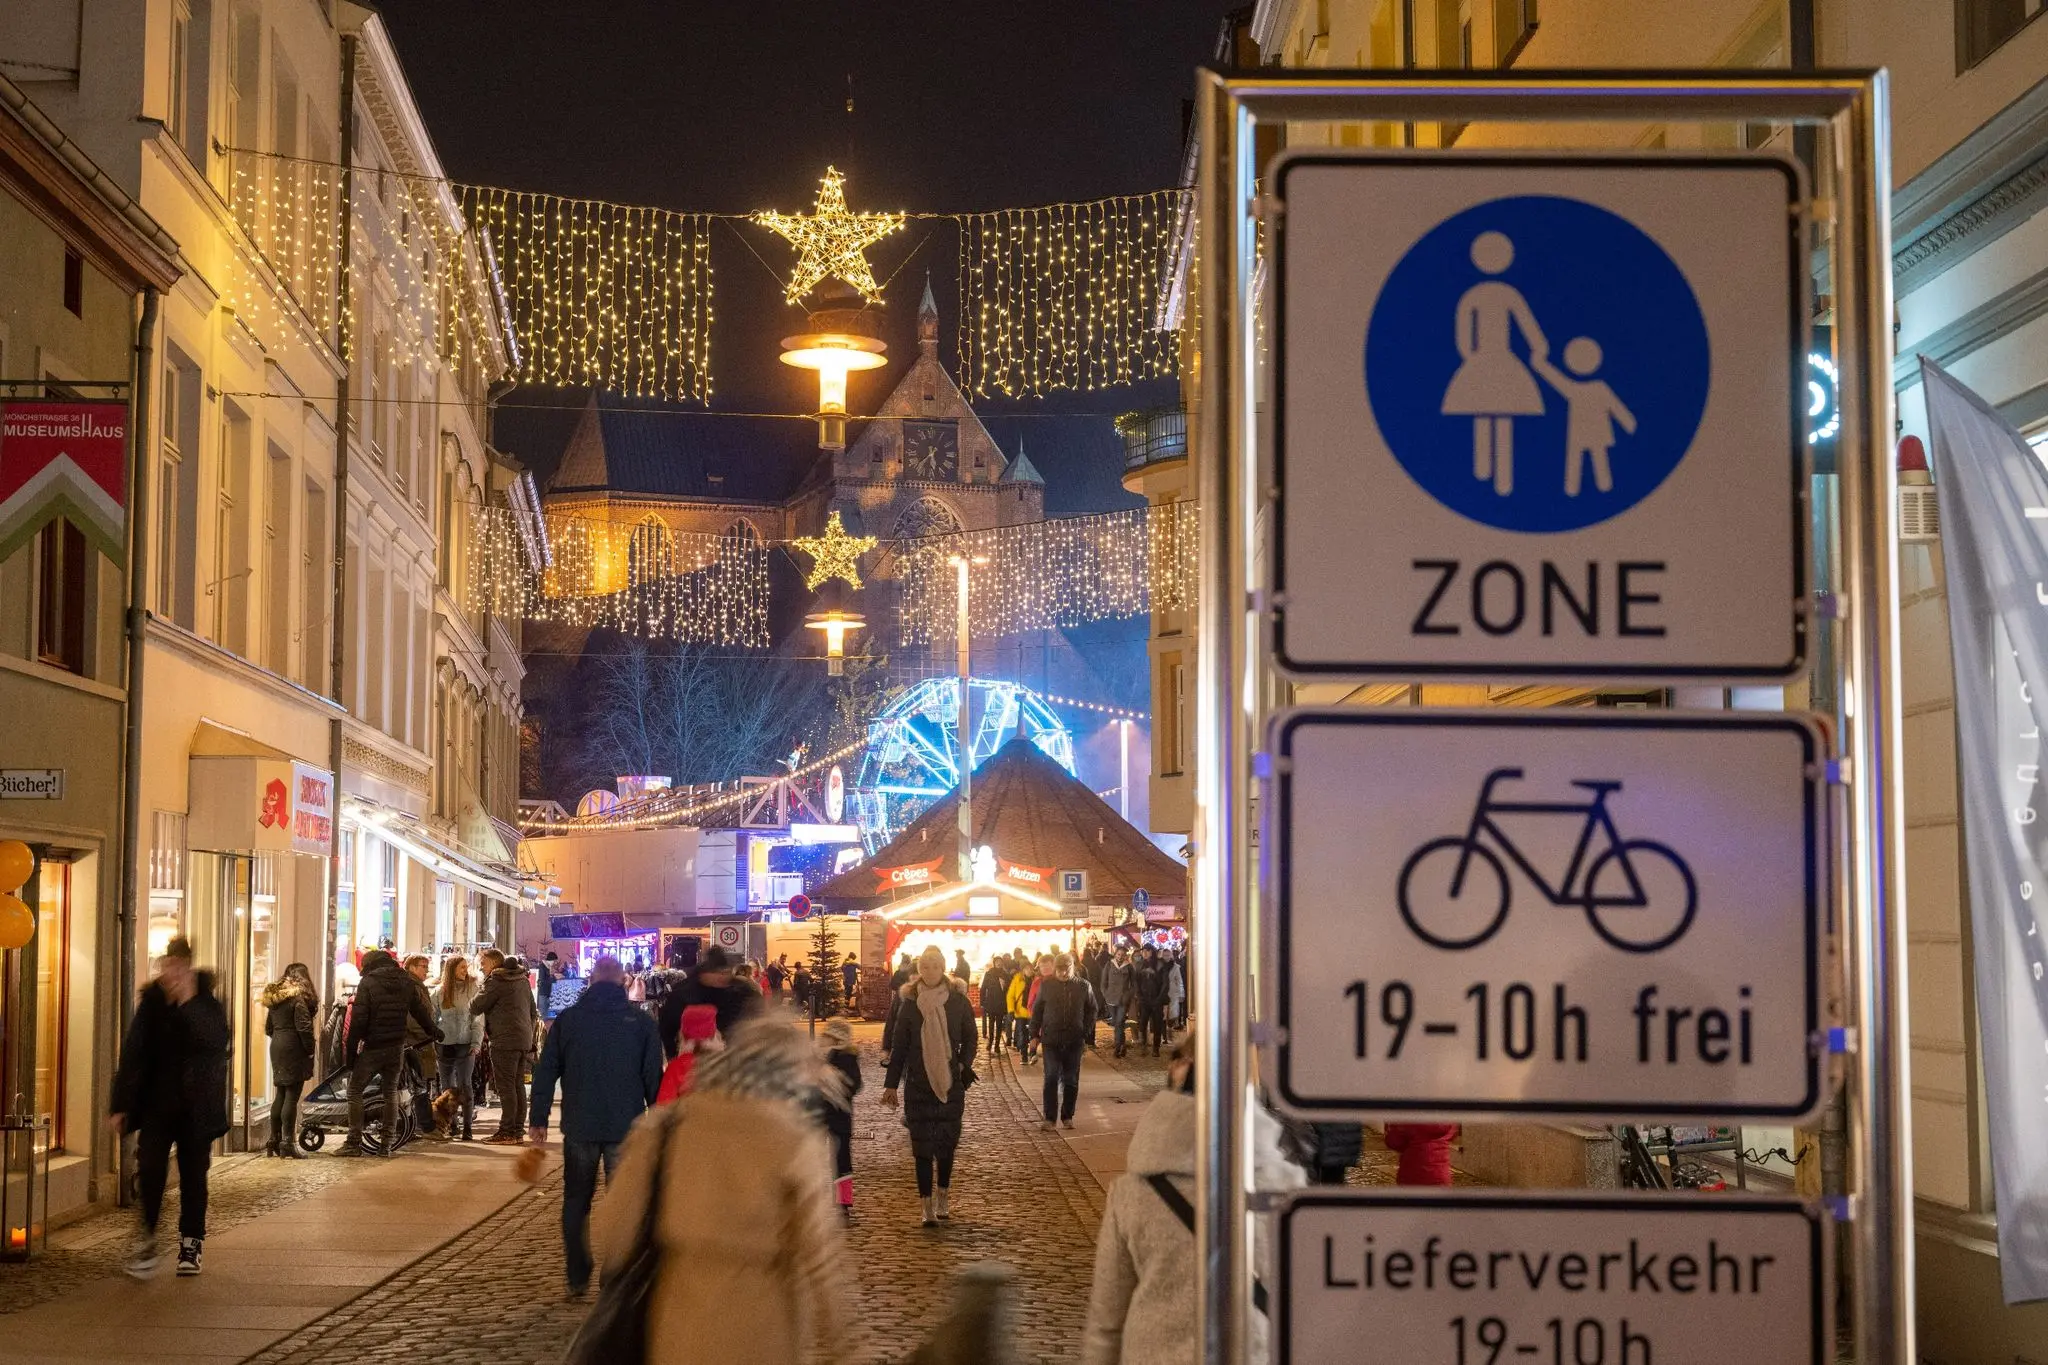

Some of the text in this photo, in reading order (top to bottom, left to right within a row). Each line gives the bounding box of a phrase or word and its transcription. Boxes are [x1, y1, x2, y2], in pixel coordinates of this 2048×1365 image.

[3, 413, 124, 438] MUSEUMSHAUS
[1410, 558, 1668, 638] ZONE
[0, 776, 56, 793] Bücher!
[891, 867, 929, 882] Crêpes
[1008, 866, 1041, 883] Mutzen
[1068, 876, 1078, 888] P
[724, 932, 735, 941] 30
[1632, 985, 1754, 1065] frei
[1322, 1234, 1776, 1293] Lieferverkehr
